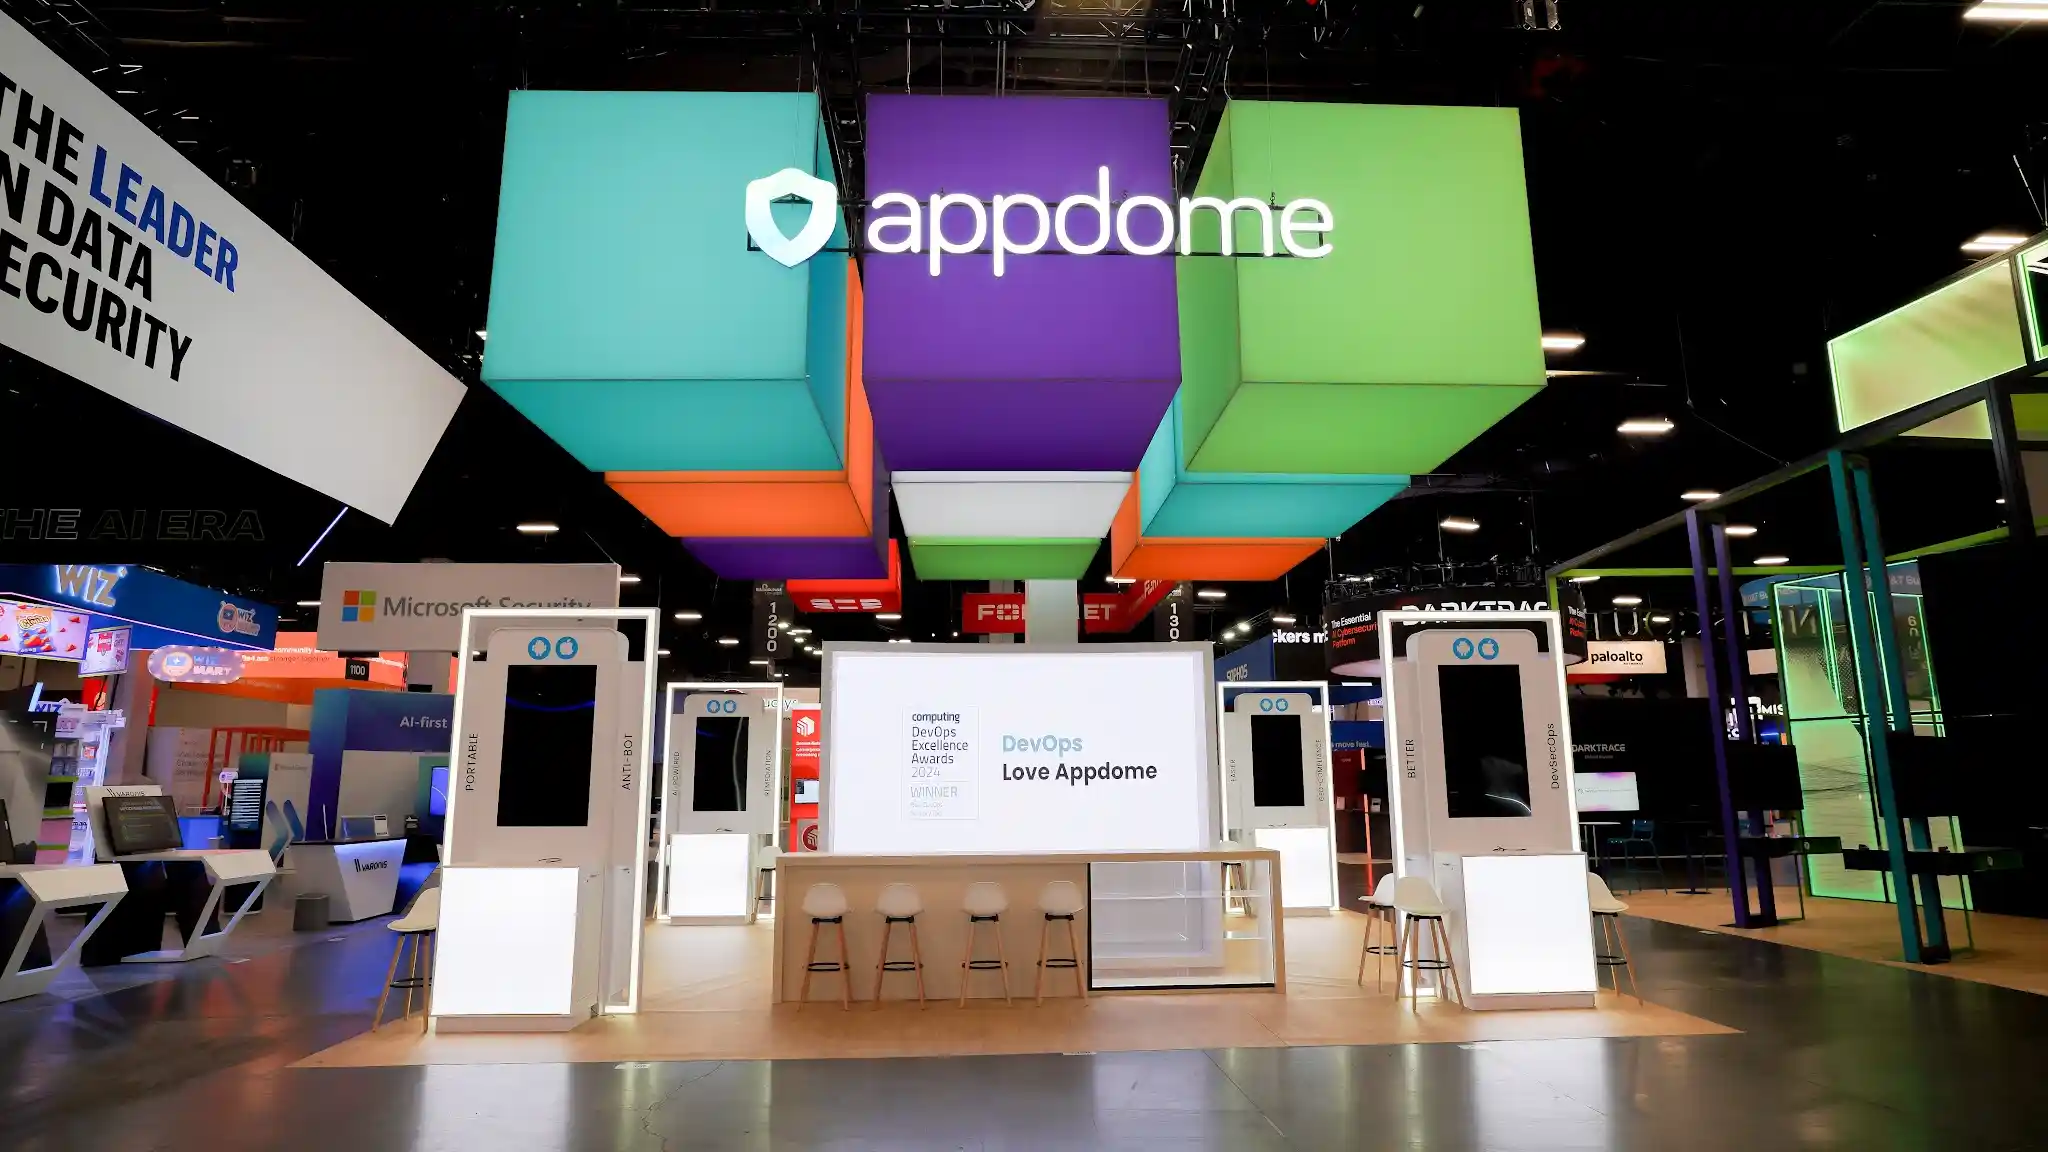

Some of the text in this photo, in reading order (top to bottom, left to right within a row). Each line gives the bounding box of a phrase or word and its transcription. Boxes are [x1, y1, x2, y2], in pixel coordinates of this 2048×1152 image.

[0, 72, 239, 293] THE LEADER
[866, 166, 1334, 277] appdome
[37, 180, 152, 303] DATA
[0, 228, 193, 382] ECURITY
[0, 509, 266, 541] HE AI ERA
[55, 564, 117, 607] WIZ
[766, 601, 778, 652] 1200
[1168, 602, 1180, 642] 130
[1331, 611, 1372, 629] The Essential
[1337, 622, 1378, 642] Cybersecuri
[1590, 650, 1643, 664] paloalto
[350, 664, 366, 676] 1100
[399, 716, 448, 729] AI-first
[911, 712, 960, 724] computing
[911, 739, 969, 751] Excellence
[912, 726, 957, 740] DevOps
[911, 753, 954, 764] Awards
[1002, 735, 1083, 757] DevOps
[1546, 723, 1560, 790] DevSecOps
[1571, 744, 1626, 753] DARKTRACE
[465, 732, 478, 791] PORTABLE
[621, 733, 633, 790] ANTI-BOT
[1405, 739, 1416, 779] BETTER
[764, 750, 772, 797] REMEDIATION
[911, 766, 940, 778] 2024
[1002, 761, 1158, 786] Love Appdome
[910, 786, 958, 798] WINNER
